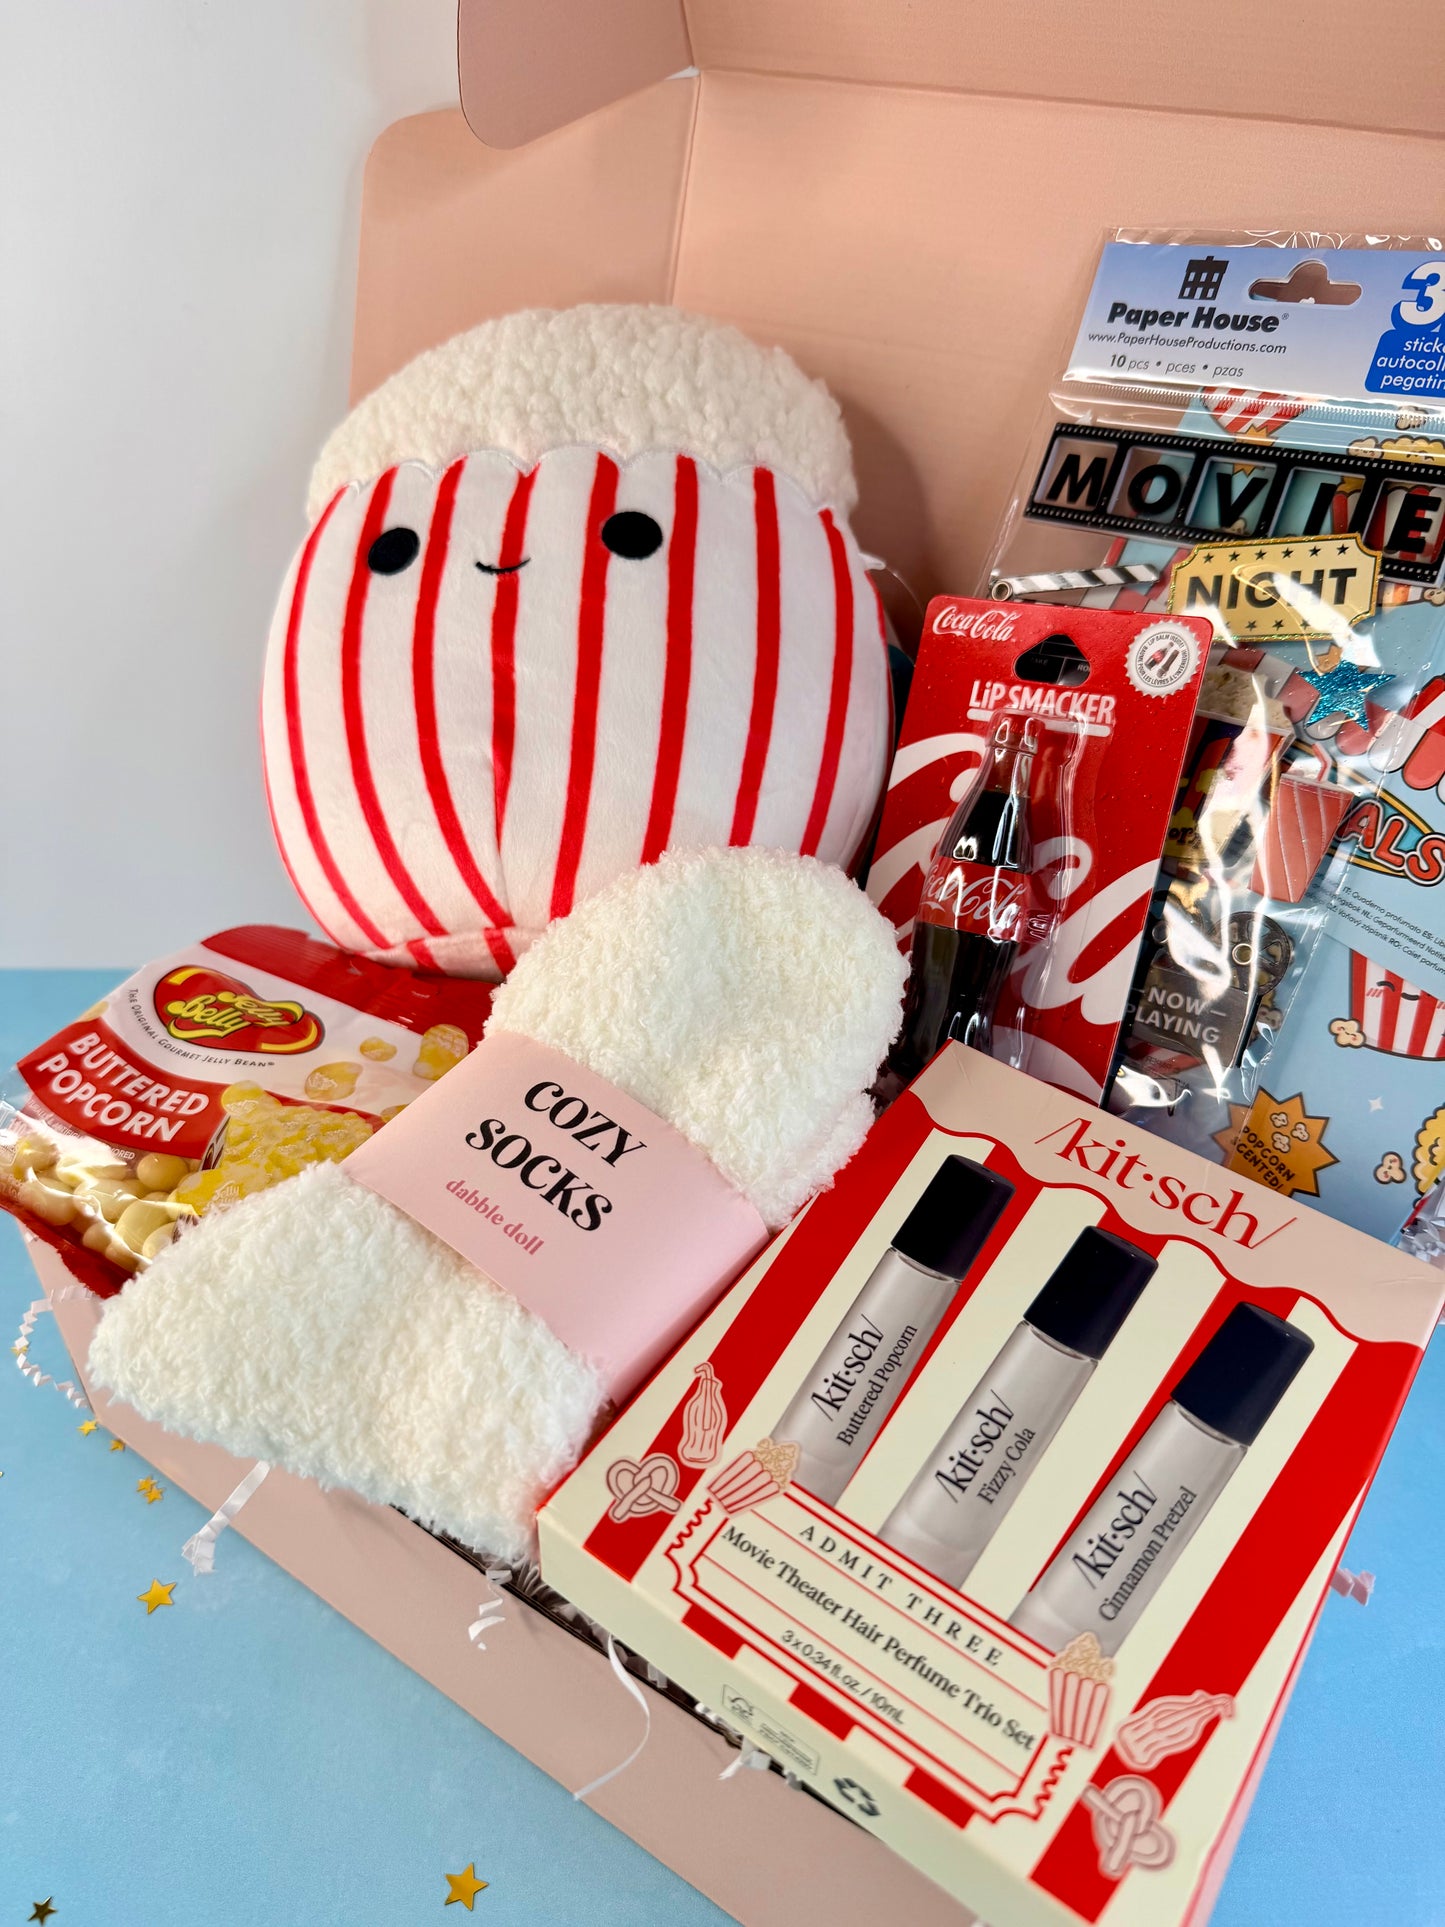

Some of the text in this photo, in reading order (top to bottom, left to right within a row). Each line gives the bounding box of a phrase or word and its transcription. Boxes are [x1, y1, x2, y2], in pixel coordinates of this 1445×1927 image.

[1088, 332, 1287, 354] www.PaperHouseProductions.com
[1106, 302, 1189, 331] Paper
[1403, 336, 1445, 354] stick
[1109, 354, 1244, 378] 10 pcs pces pzas
[1046, 453, 1441, 556] MOVIE
[1187, 567, 1357, 610] NIGHT
[1007, 686, 1117, 725] SMACKER
[165, 993, 251, 1039] Belly
[217, 991, 304, 1028] Jelly
[1125, 1003, 1221, 1044] PLAYING
[1147, 986, 1208, 1016] NOW
[69, 1031, 210, 1117] BUTTERED
[158, 1038, 201, 1061] GOURMET
[201, 1055, 231, 1066] JELLY
[37, 1052, 186, 1142] POPCORN
[524, 1081, 648, 1168] COZY
[465, 1118, 613, 1232] SOCKS
[1241, 1125, 1296, 1182] POPCORN
[446, 1179, 545, 1255] dabble doll
[836, 1324, 918, 1447] Buttered Popcorn
[977, 1427, 1036, 1506] Fizzy Cola
[1098, 1485, 1198, 1622] Cinnamon Pretzel
[799, 1525, 1004, 1668] ADMIT THREE
[721, 1526, 1036, 1752] Movie Theater Hair Perfume Trio Set
